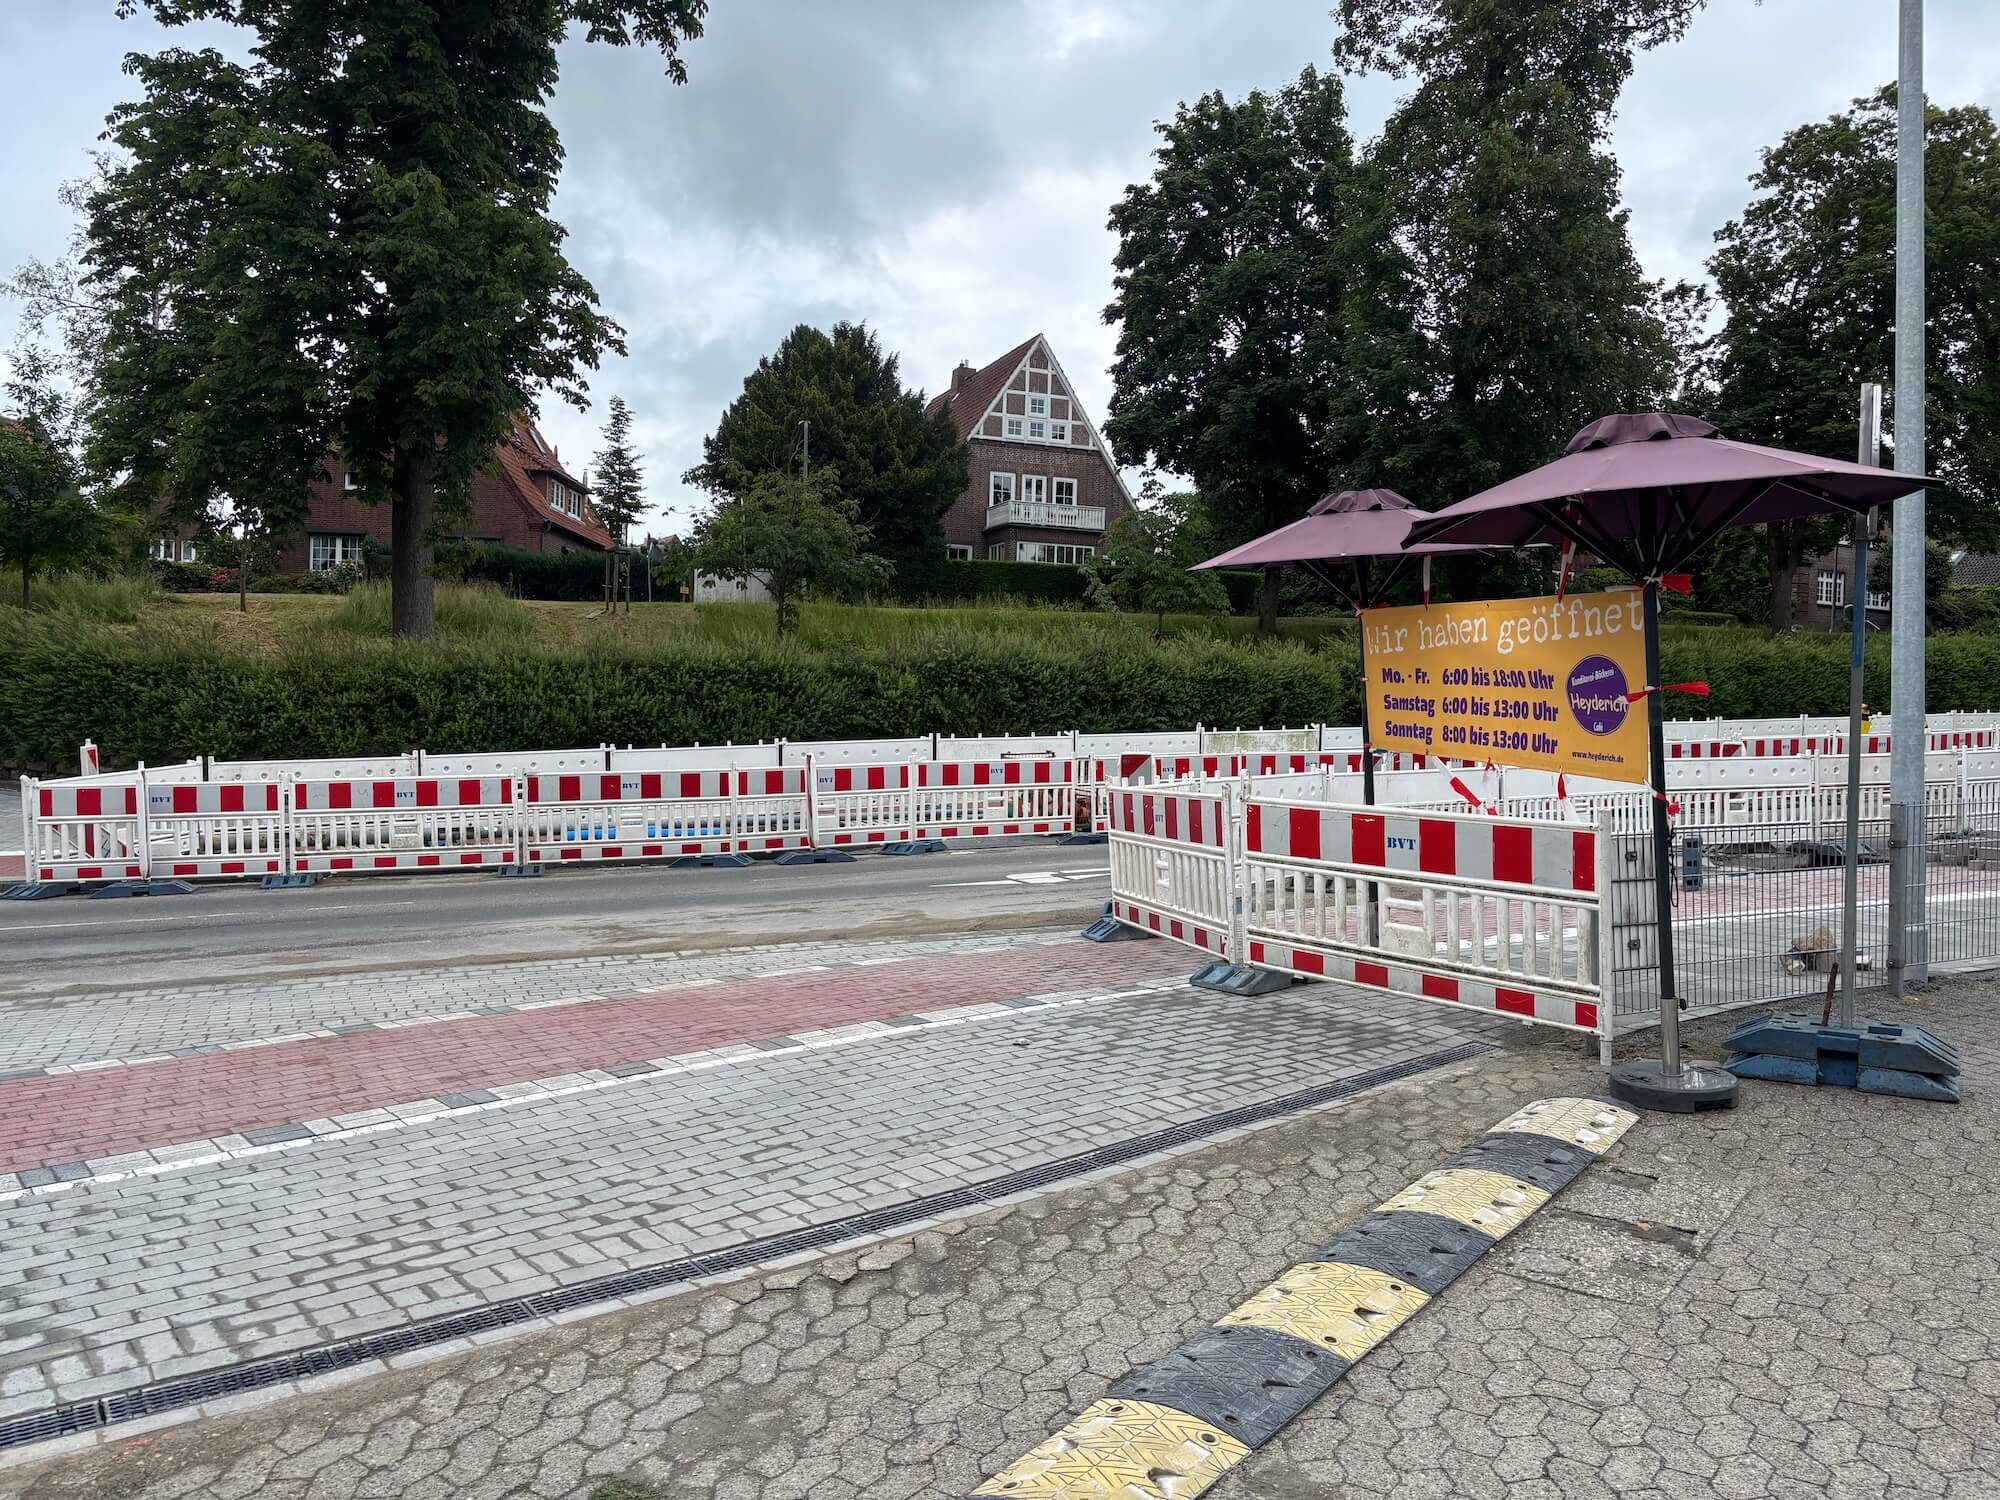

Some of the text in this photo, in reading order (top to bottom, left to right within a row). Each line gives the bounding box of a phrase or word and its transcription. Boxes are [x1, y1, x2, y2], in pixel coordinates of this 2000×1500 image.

[1366, 591, 1643, 655] Wir haben geöffnet
[1382, 668, 1405, 684] Mo.
[1415, 668, 1430, 684] Fr.
[1442, 668, 1468, 685] 6:00
[1471, 667, 1490, 686] bis
[1493, 669, 1526, 688] 18:00
[1528, 669, 1554, 689] Uhr
[1384, 694, 1558, 721] Samstag 6:00 bis 13:00 Uhr
[1570, 692, 1627, 715] Heyderich
[1385, 720, 1558, 754] Sonntag 8:00 bis 13:00 Uhr
[1571, 751, 1624, 763] www.heyderich.de
[396, 791, 415, 799] BVT
[622, 782, 640, 790] BVT
[1387, 836, 1416, 850] BVT
